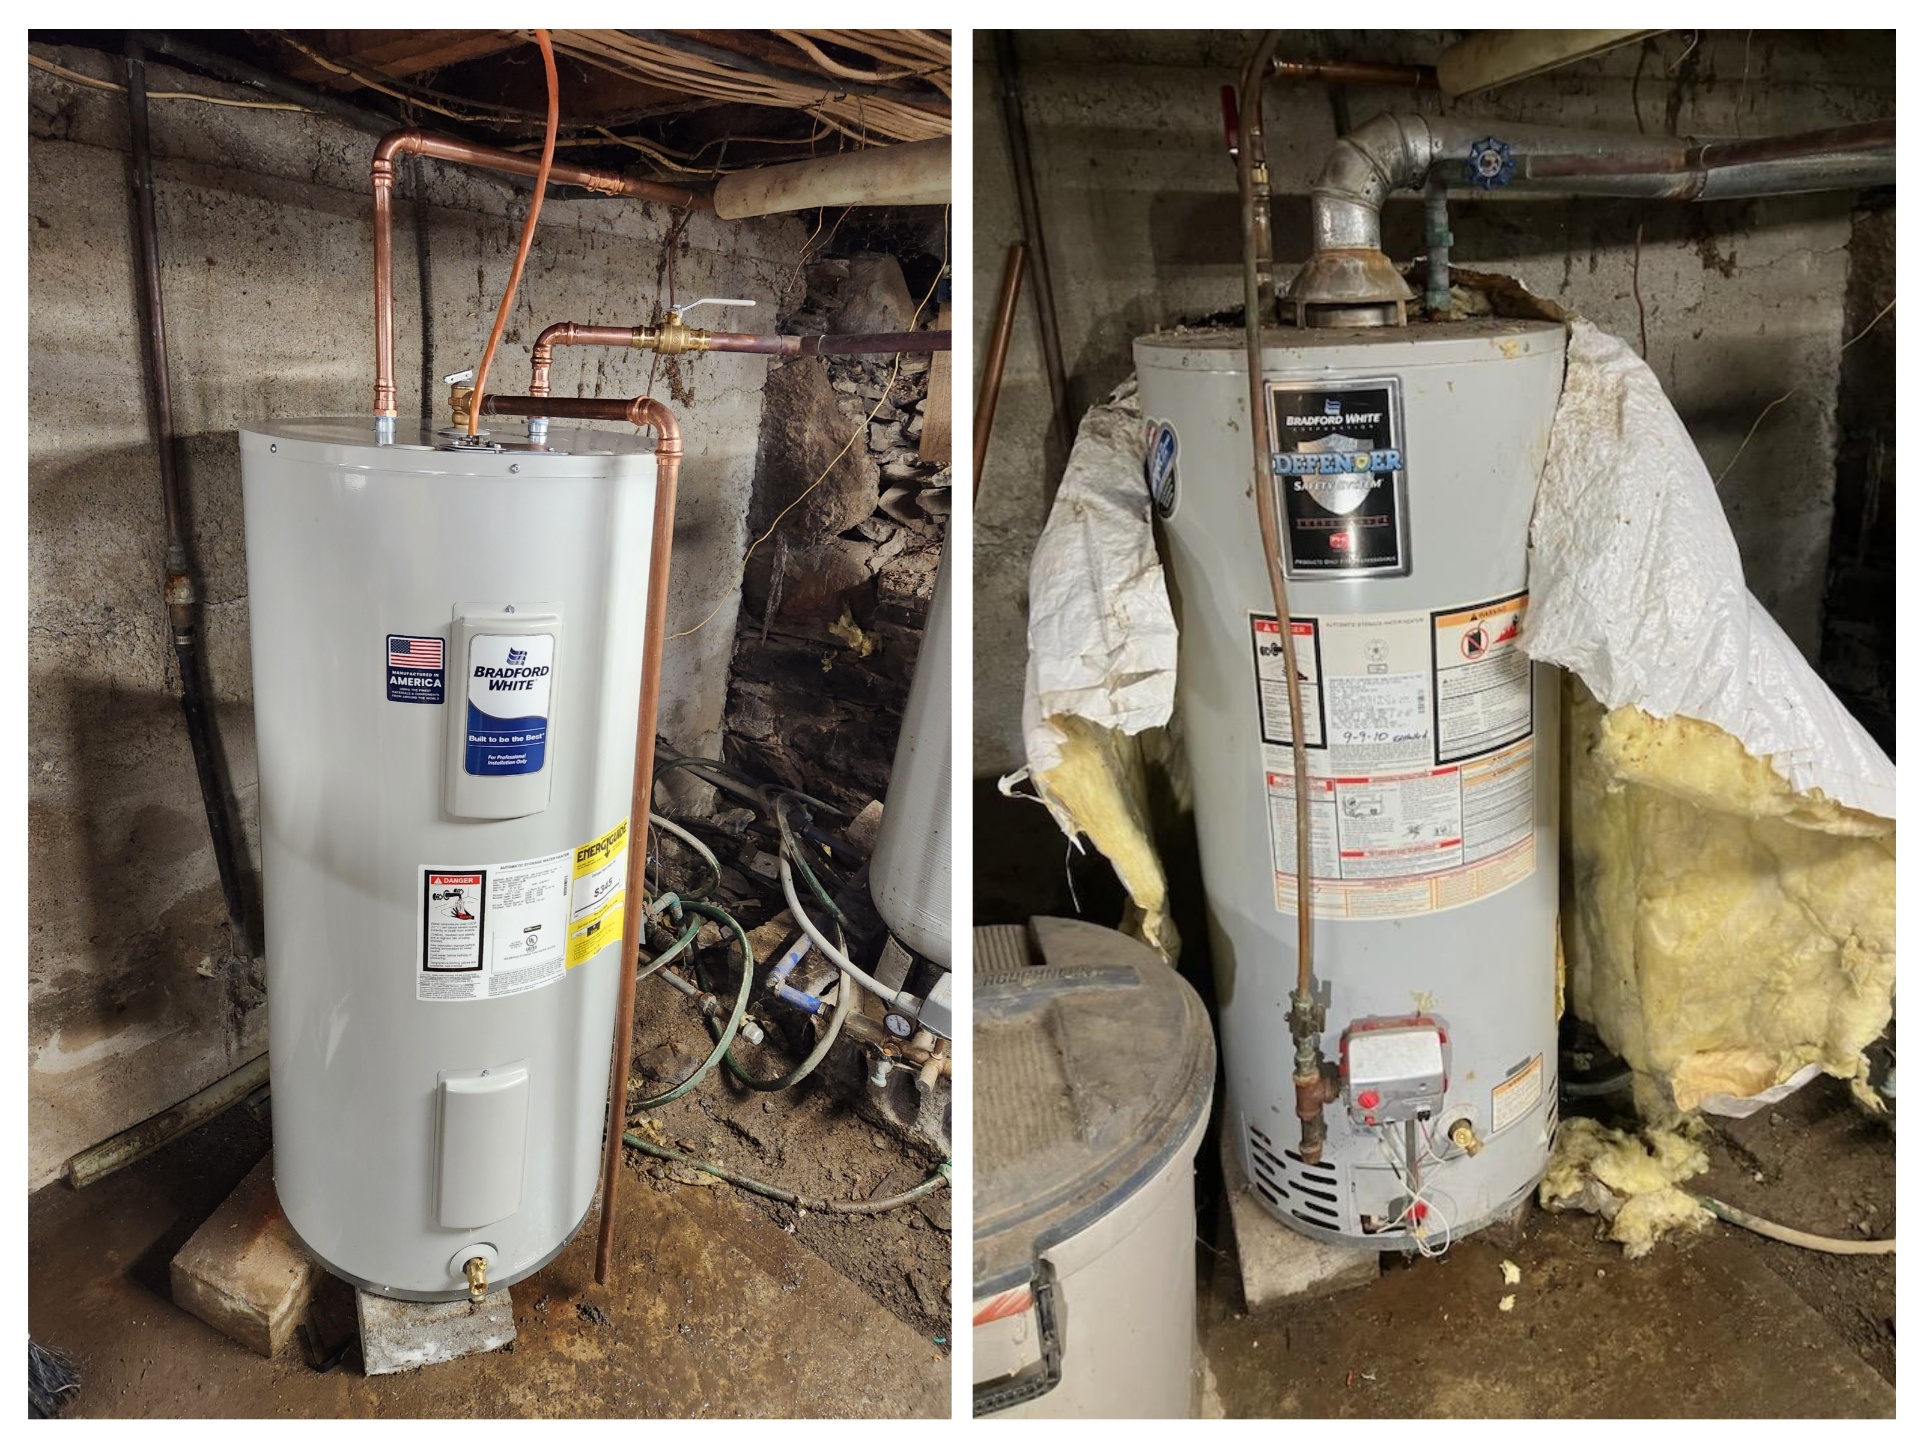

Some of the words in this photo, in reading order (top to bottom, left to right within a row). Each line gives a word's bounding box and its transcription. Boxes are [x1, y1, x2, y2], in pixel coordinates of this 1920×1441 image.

[1286, 415, 1343, 426] BRADFORD
[1346, 413, 1381, 423] WHITE
[1273, 450, 1403, 475] DEFENDER
[1294, 481, 1333, 492] SAFETY
[474, 666, 549, 678] BRADFORD
[390, 676, 442, 688] AMERICA
[489, 680, 535, 691] WHITE
[468, 735, 487, 743] Built
[525, 733, 542, 741] Best
[1343, 731, 1389, 744] 9-9-10
[497, 752, 527, 760] Professional
[500, 862, 523, 870] AUTOMATIC
[524, 859, 543, 867] STORAGE
[593, 877, 613, 898] $345
